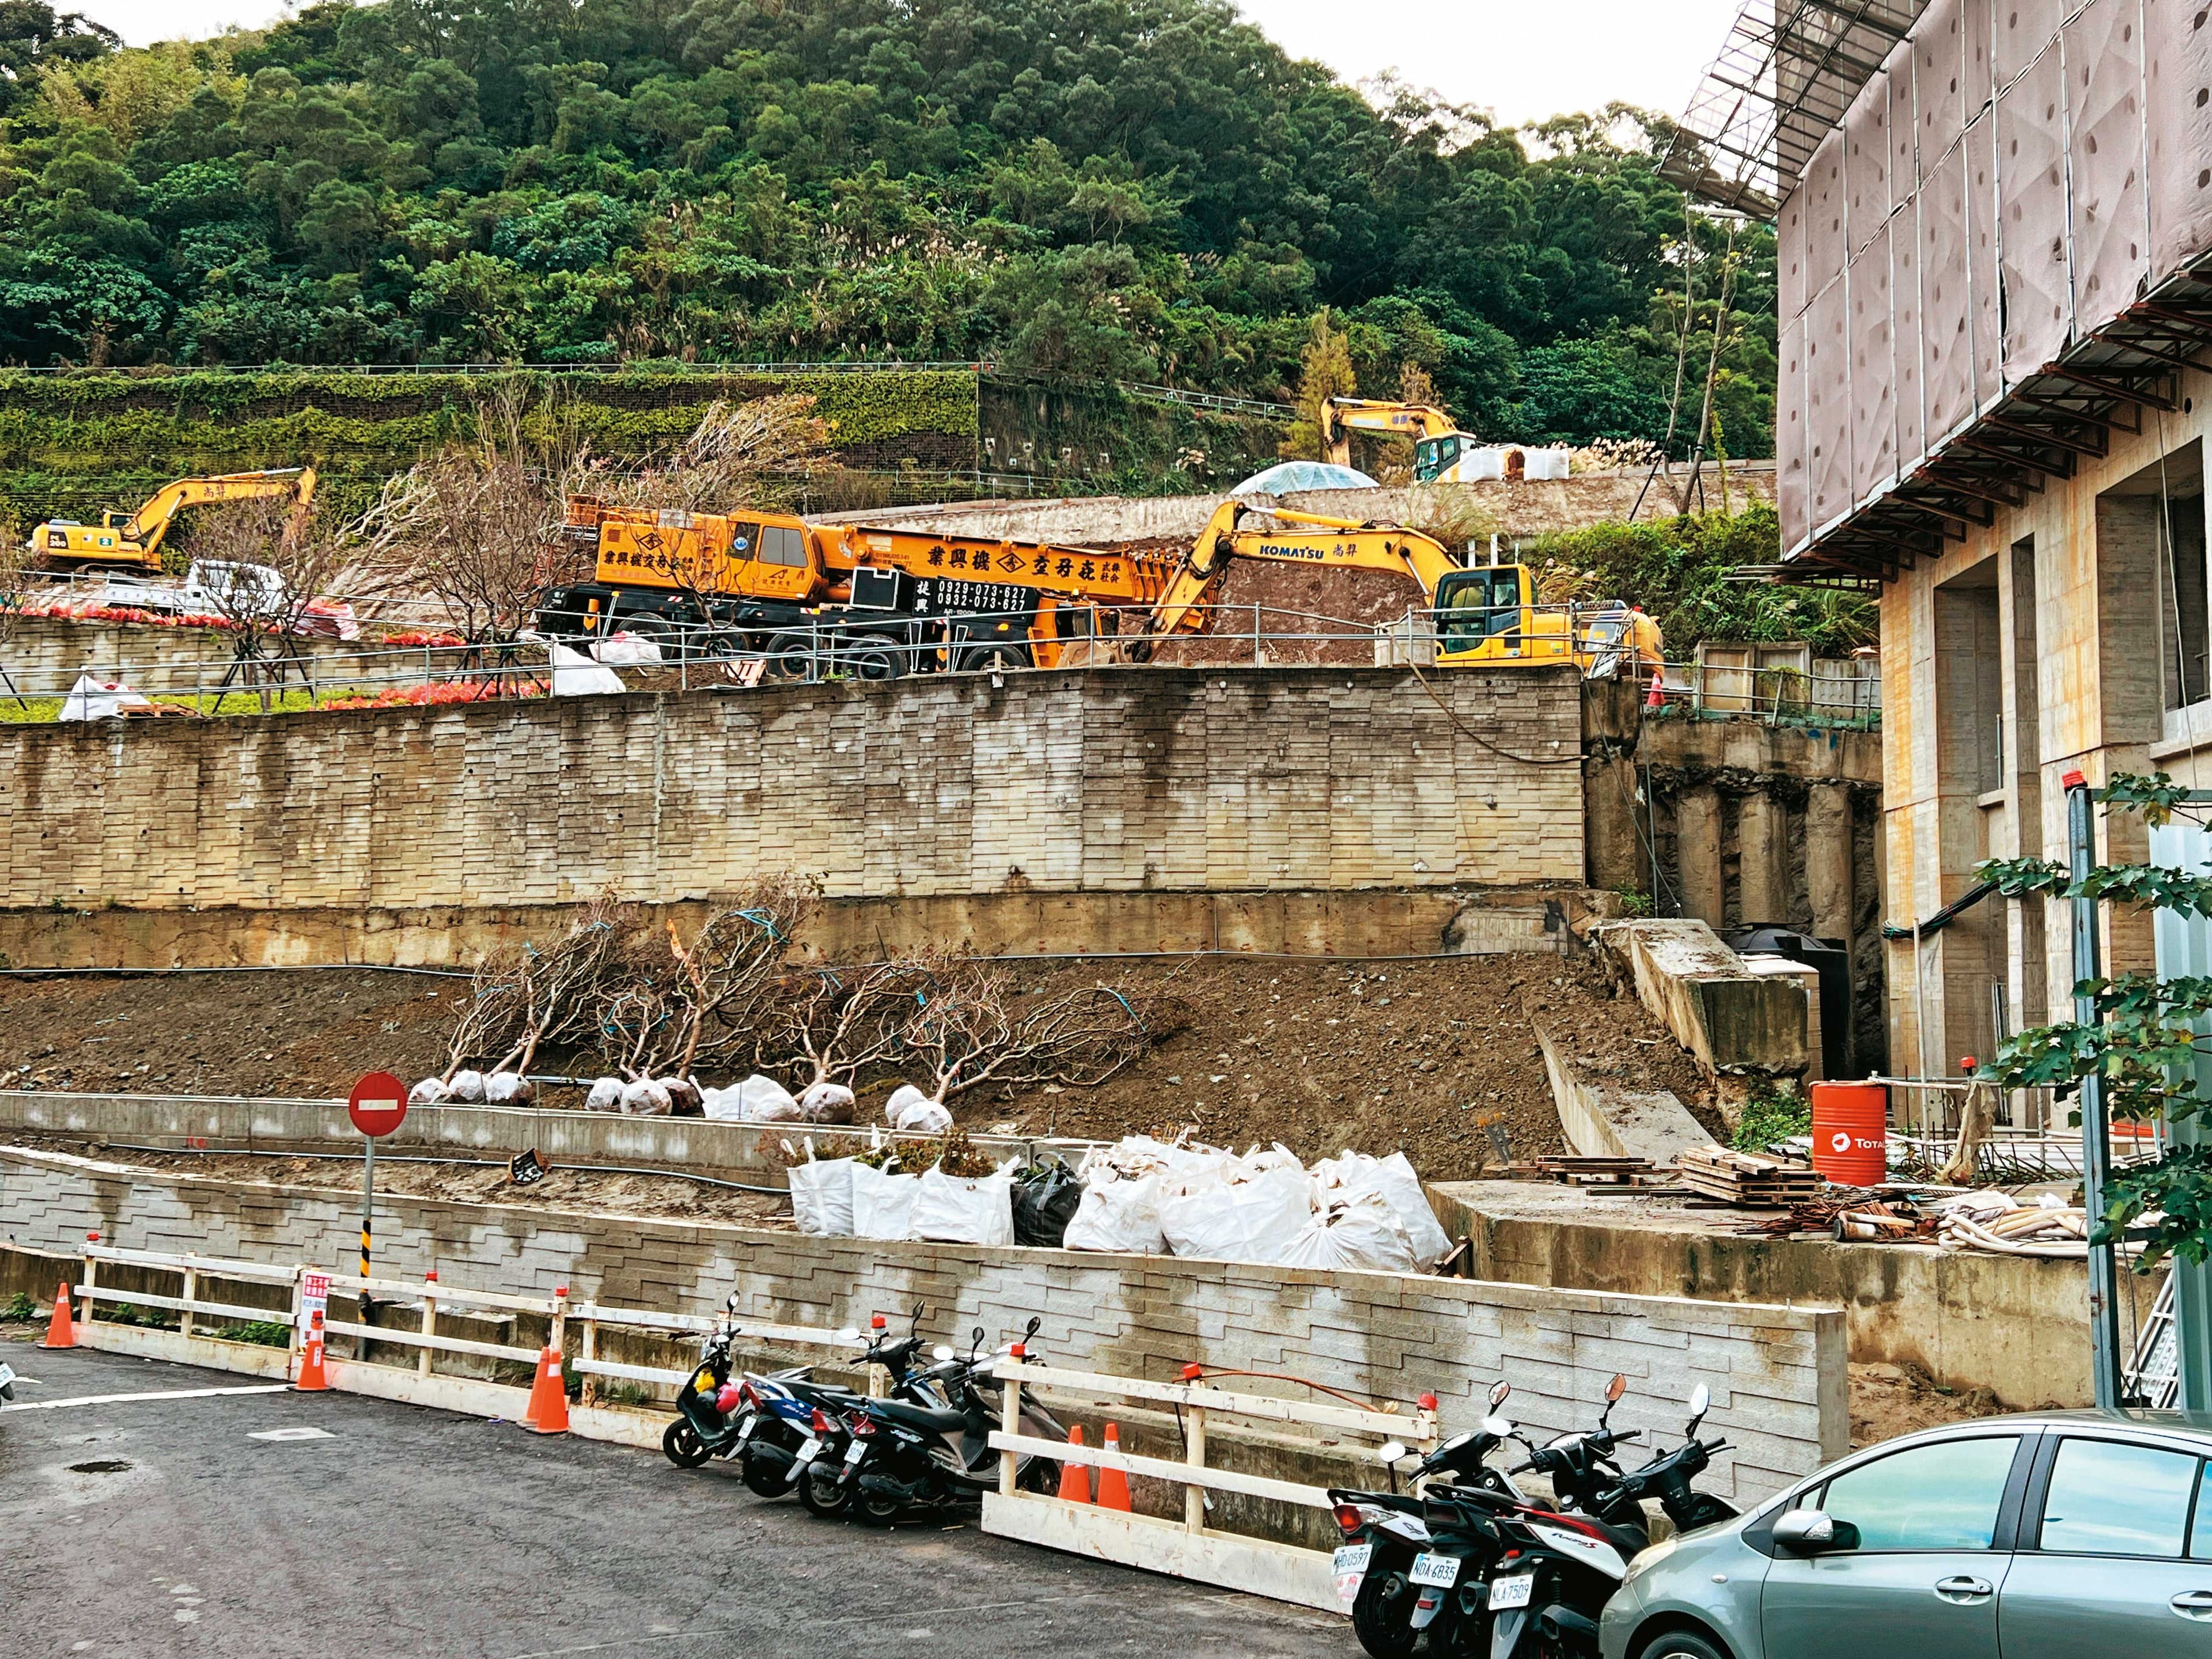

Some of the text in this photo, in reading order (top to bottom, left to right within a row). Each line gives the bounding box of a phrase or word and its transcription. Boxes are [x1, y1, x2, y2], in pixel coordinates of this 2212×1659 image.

[1260, 545, 1324, 559] KOMATSU
[1413, 1561, 1456, 1581] NDA-6835
[1491, 1584, 1529, 1602] NLA-7509
